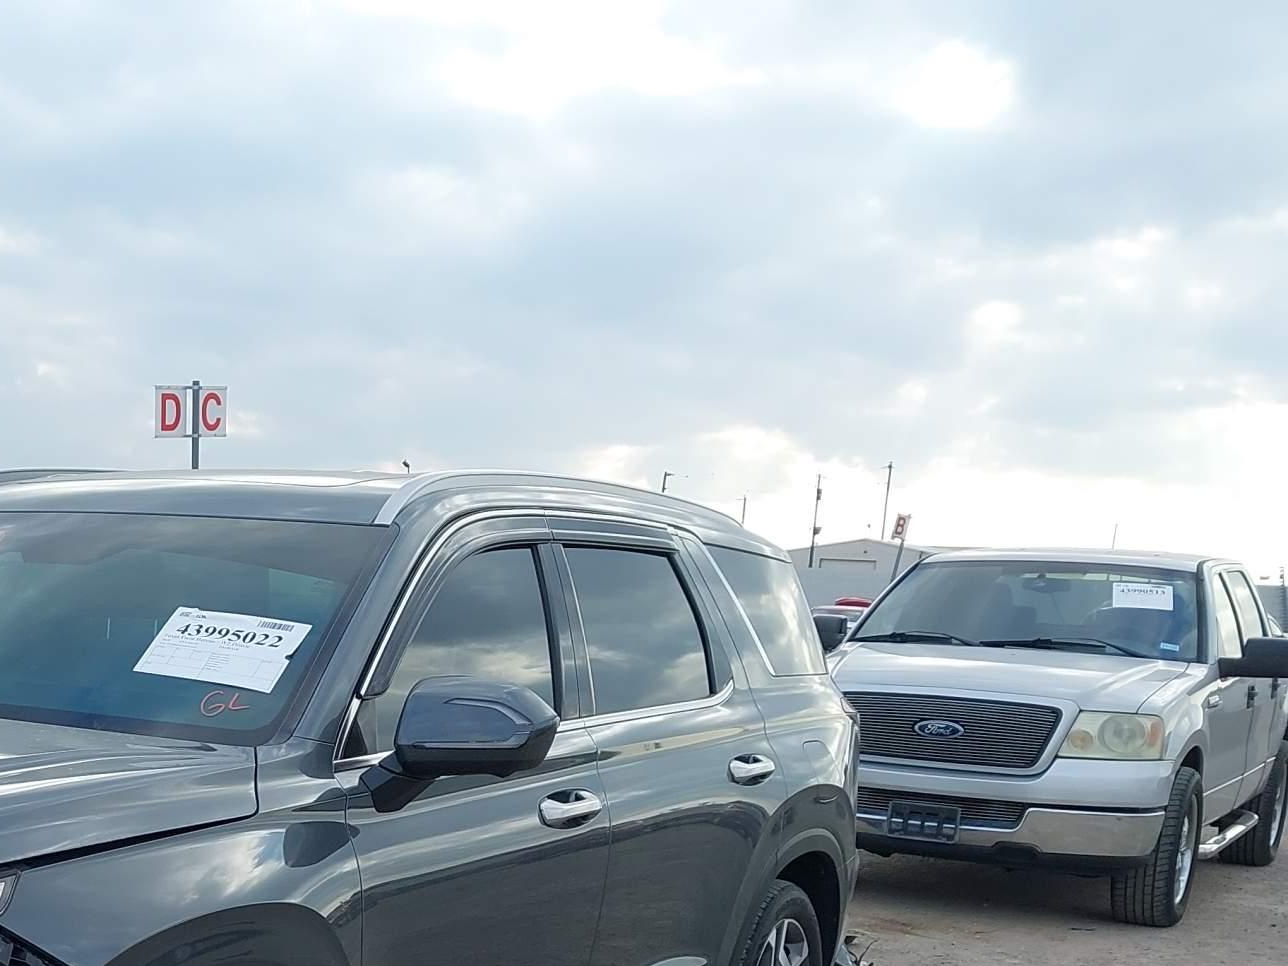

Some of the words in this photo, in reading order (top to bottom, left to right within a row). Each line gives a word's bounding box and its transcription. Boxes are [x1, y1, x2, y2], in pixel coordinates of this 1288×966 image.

[160, 392, 182, 431] D
[201, 392, 221, 431] C
[895, 516, 906, 535] B
[176, 622, 284, 648] 43995022
[200, 690, 250, 717] GL
[924, 723, 953, 736] Ford
